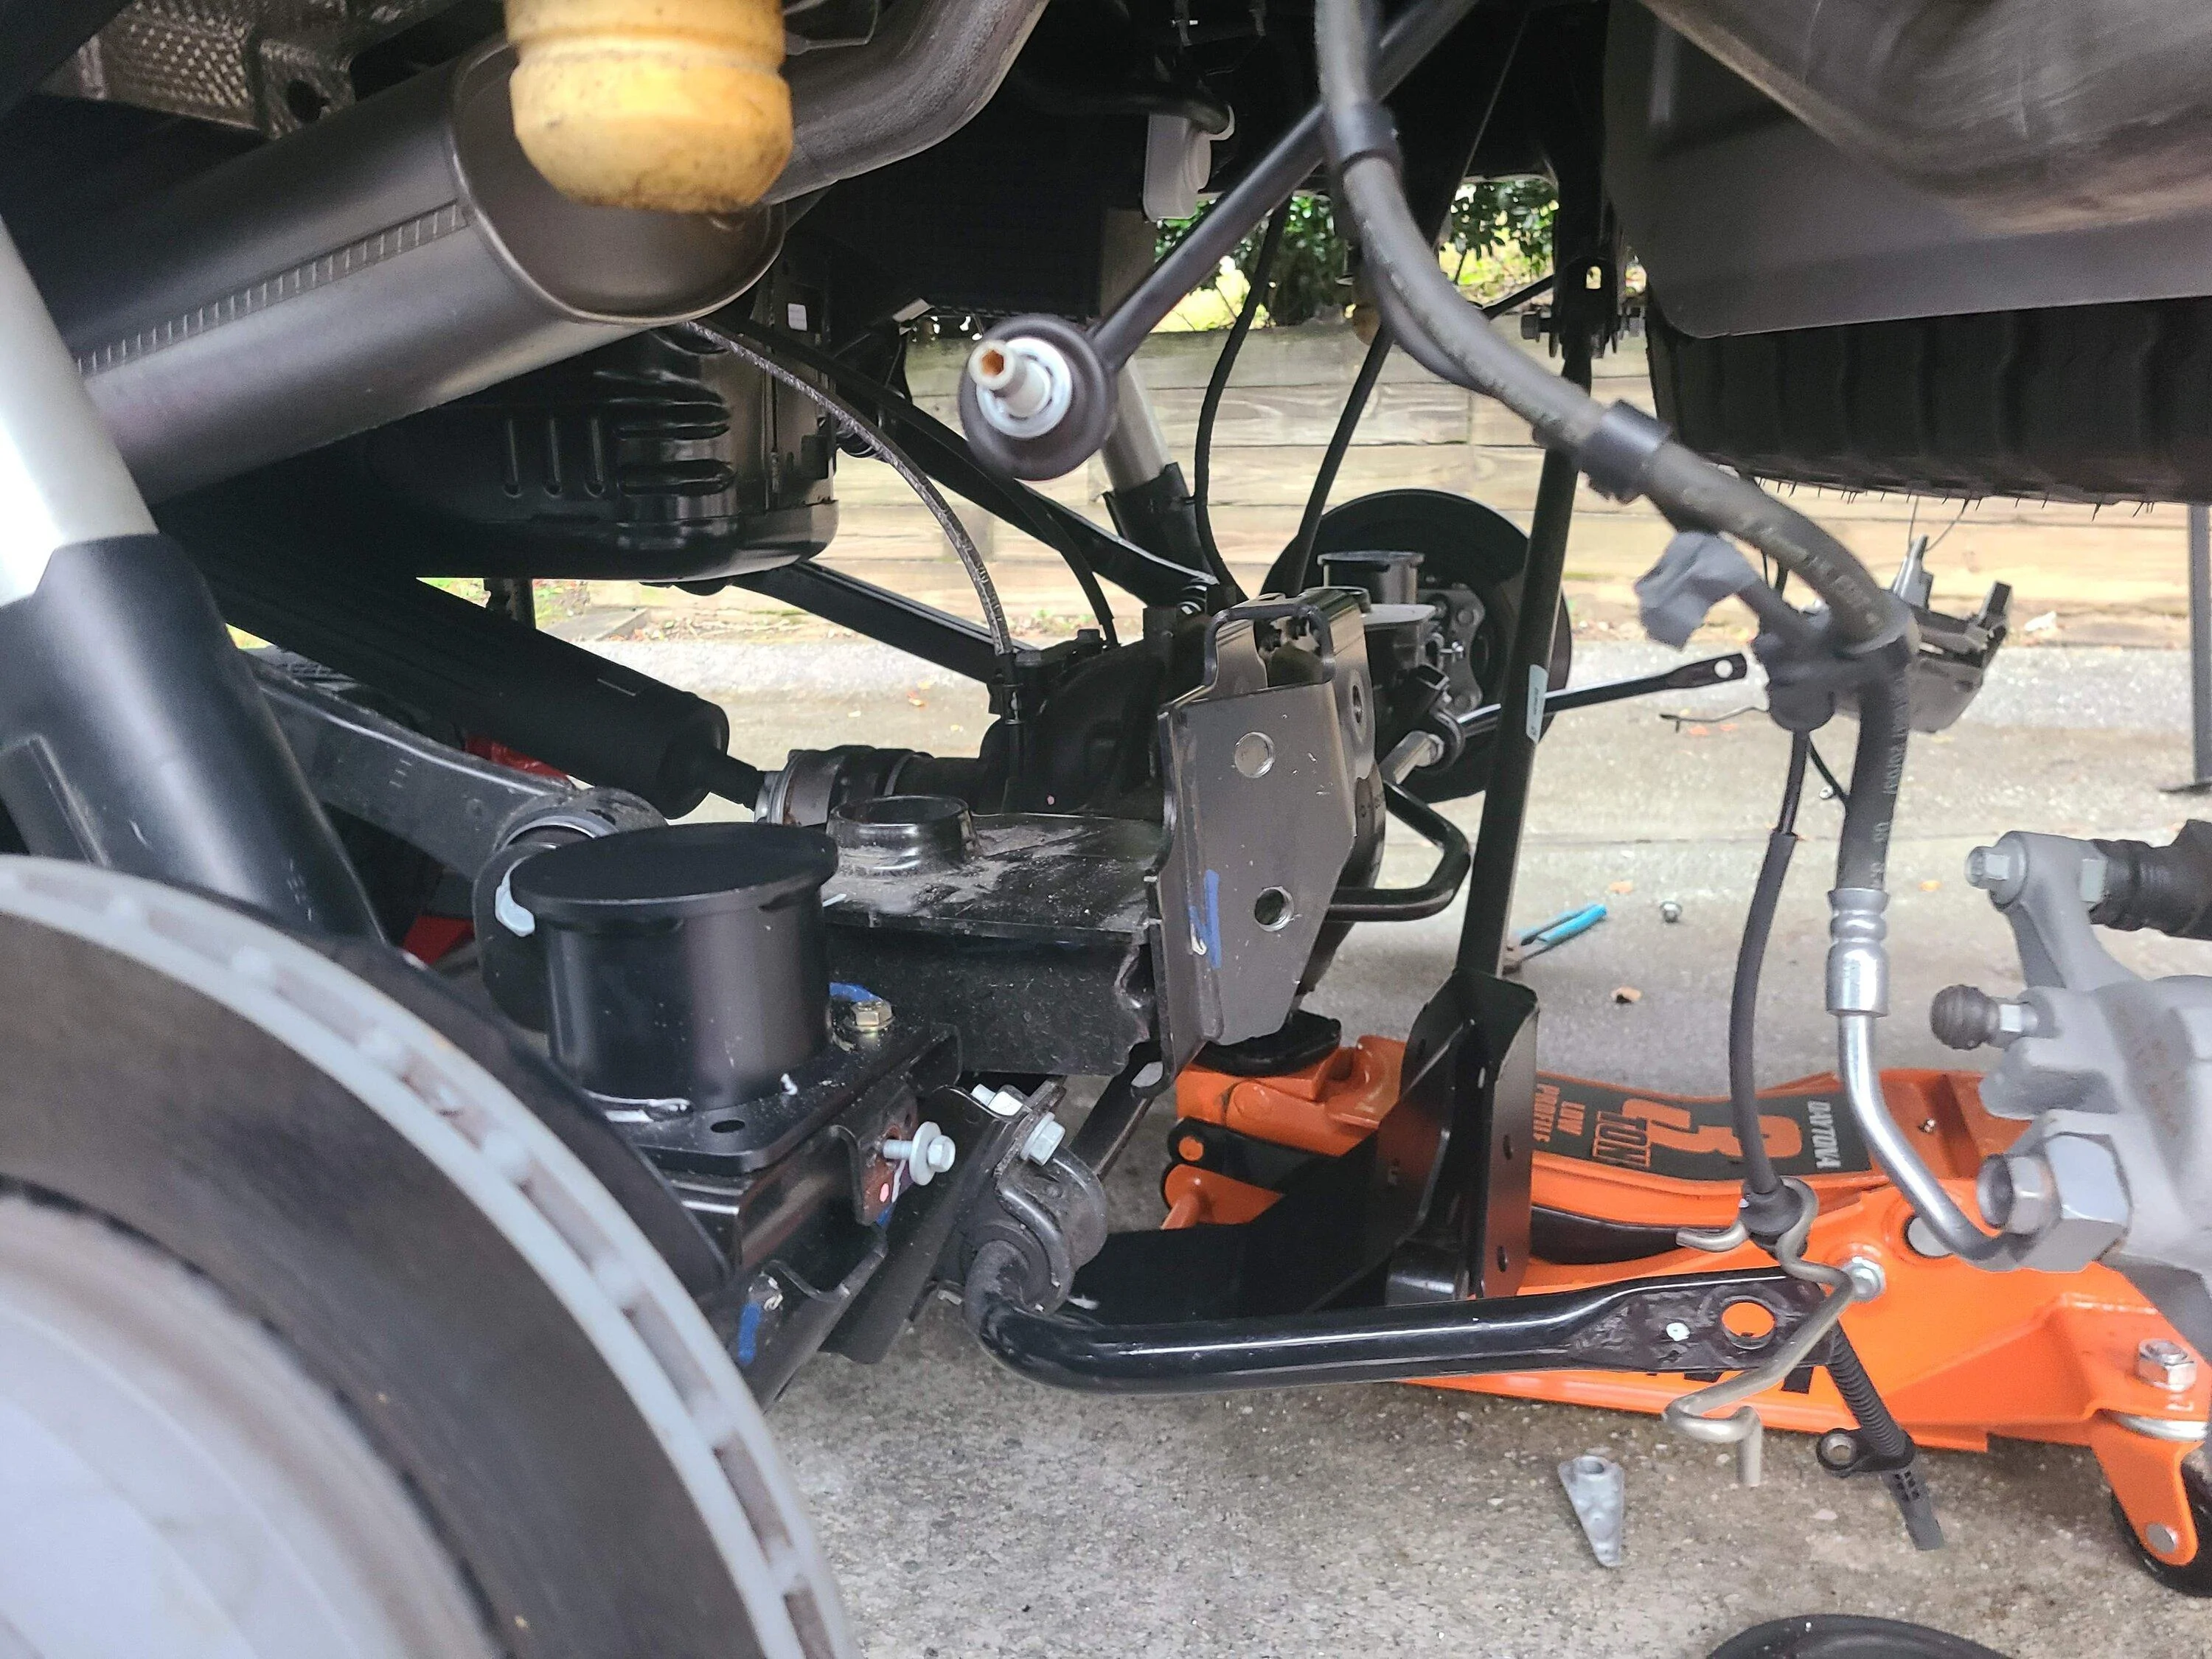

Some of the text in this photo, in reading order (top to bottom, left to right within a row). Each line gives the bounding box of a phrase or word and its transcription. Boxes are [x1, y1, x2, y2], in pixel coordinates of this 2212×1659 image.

[1532, 1082, 1561, 1142] PROFILE
[1557, 1101, 1586, 1137] LOW
[1592, 1110, 1651, 1169] TON
[1622, 1098, 1803, 1158] 3
[1807, 1100, 1842, 1169] DAYTONA
